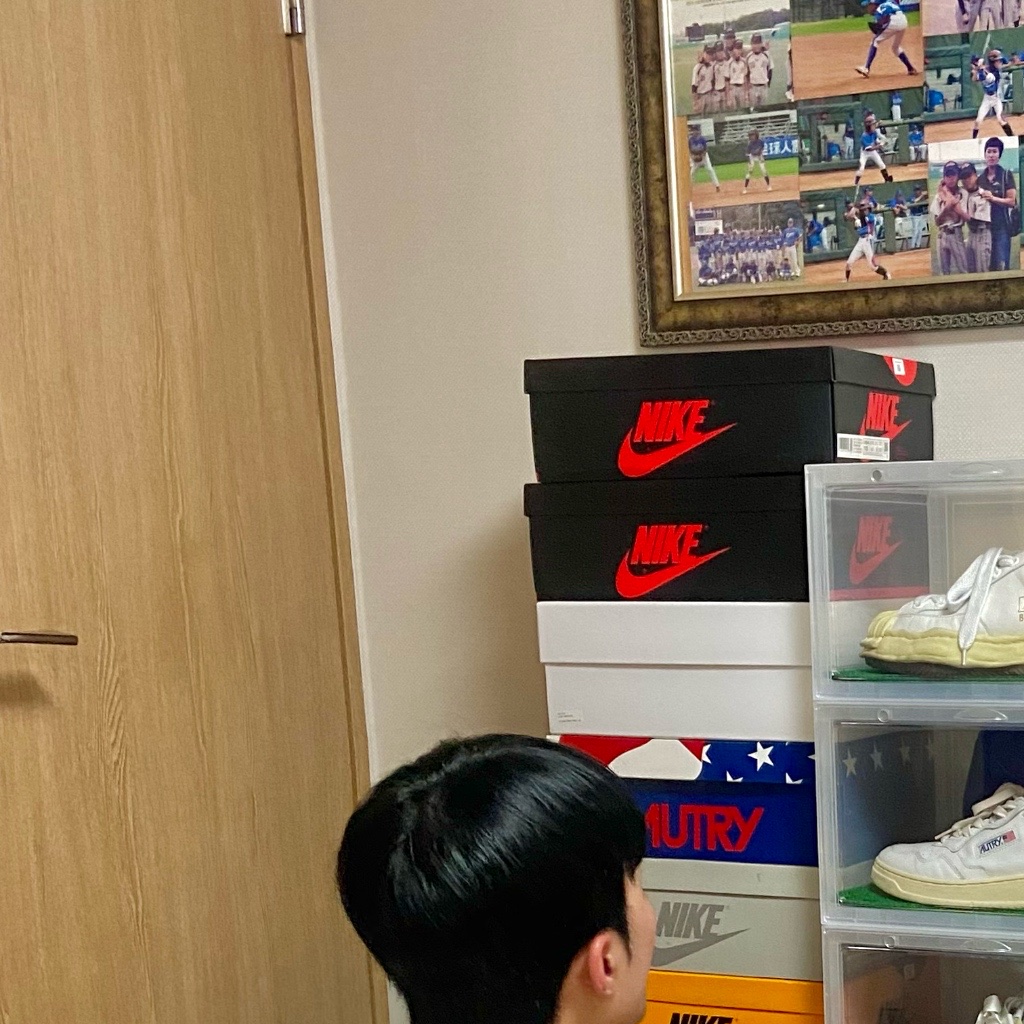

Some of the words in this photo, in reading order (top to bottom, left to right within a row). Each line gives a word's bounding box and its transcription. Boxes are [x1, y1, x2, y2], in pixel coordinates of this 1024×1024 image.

[633, 399, 711, 443] NIKE
[865, 392, 899, 428] NIKE
[630, 524, 704, 566] NIKE
[980, 836, 1002, 854] AUTRY
[655, 901, 725, 939] NIKE
